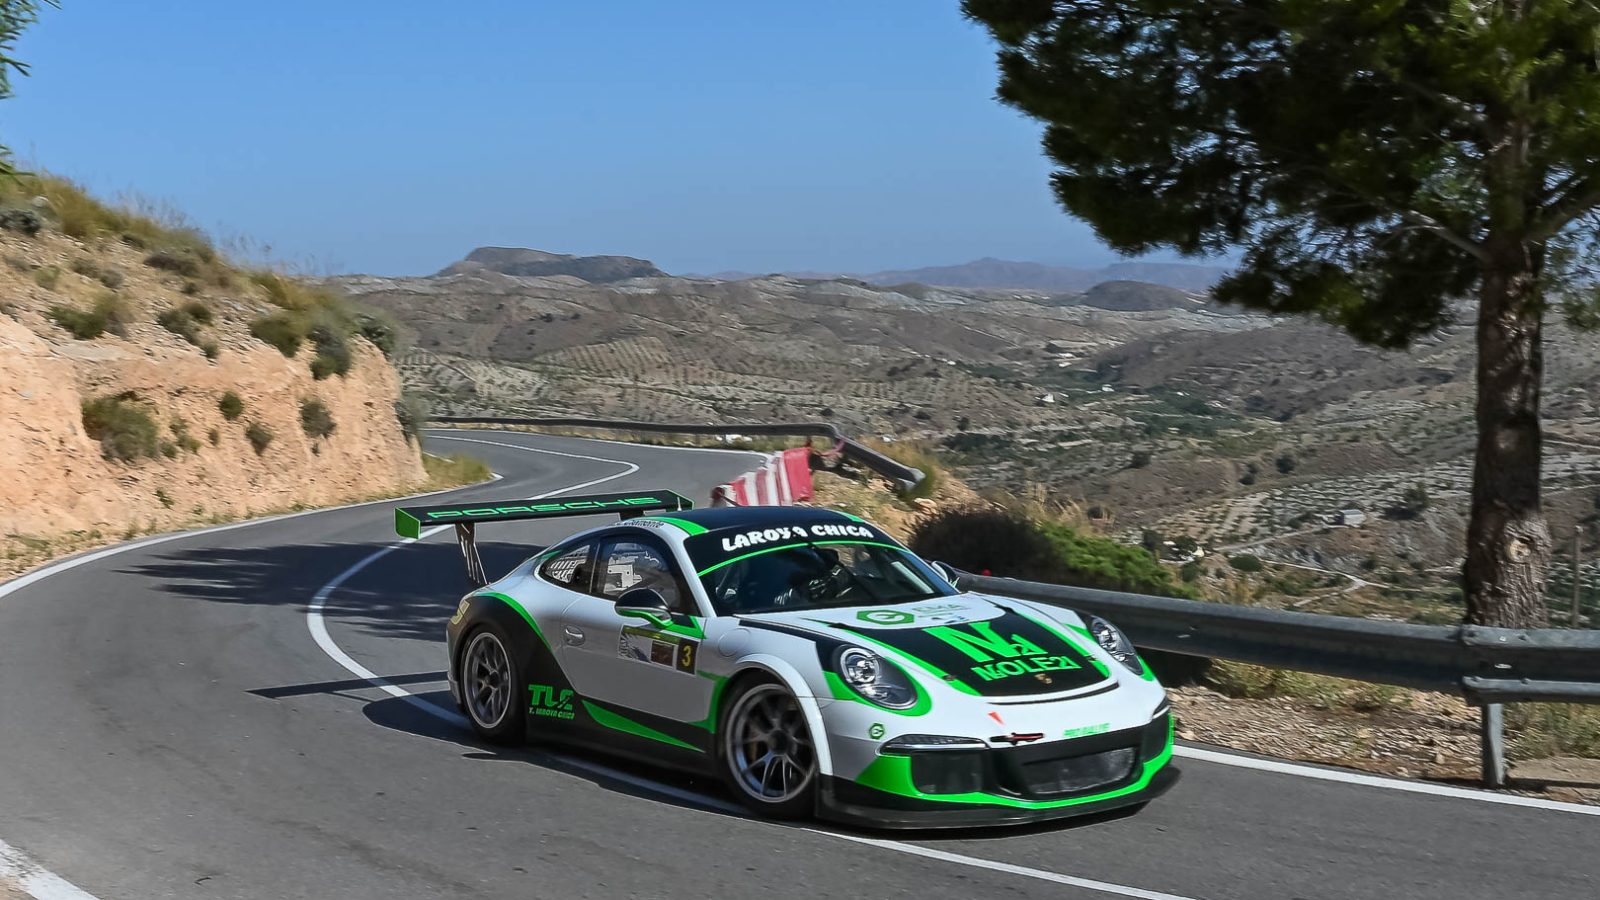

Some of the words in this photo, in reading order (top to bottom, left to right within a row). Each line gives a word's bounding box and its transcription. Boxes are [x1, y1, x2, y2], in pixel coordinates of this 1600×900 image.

[427, 497, 662, 519] PORSCHE
[811, 524, 874, 539] CHICA
[682, 645, 692, 667] 3
